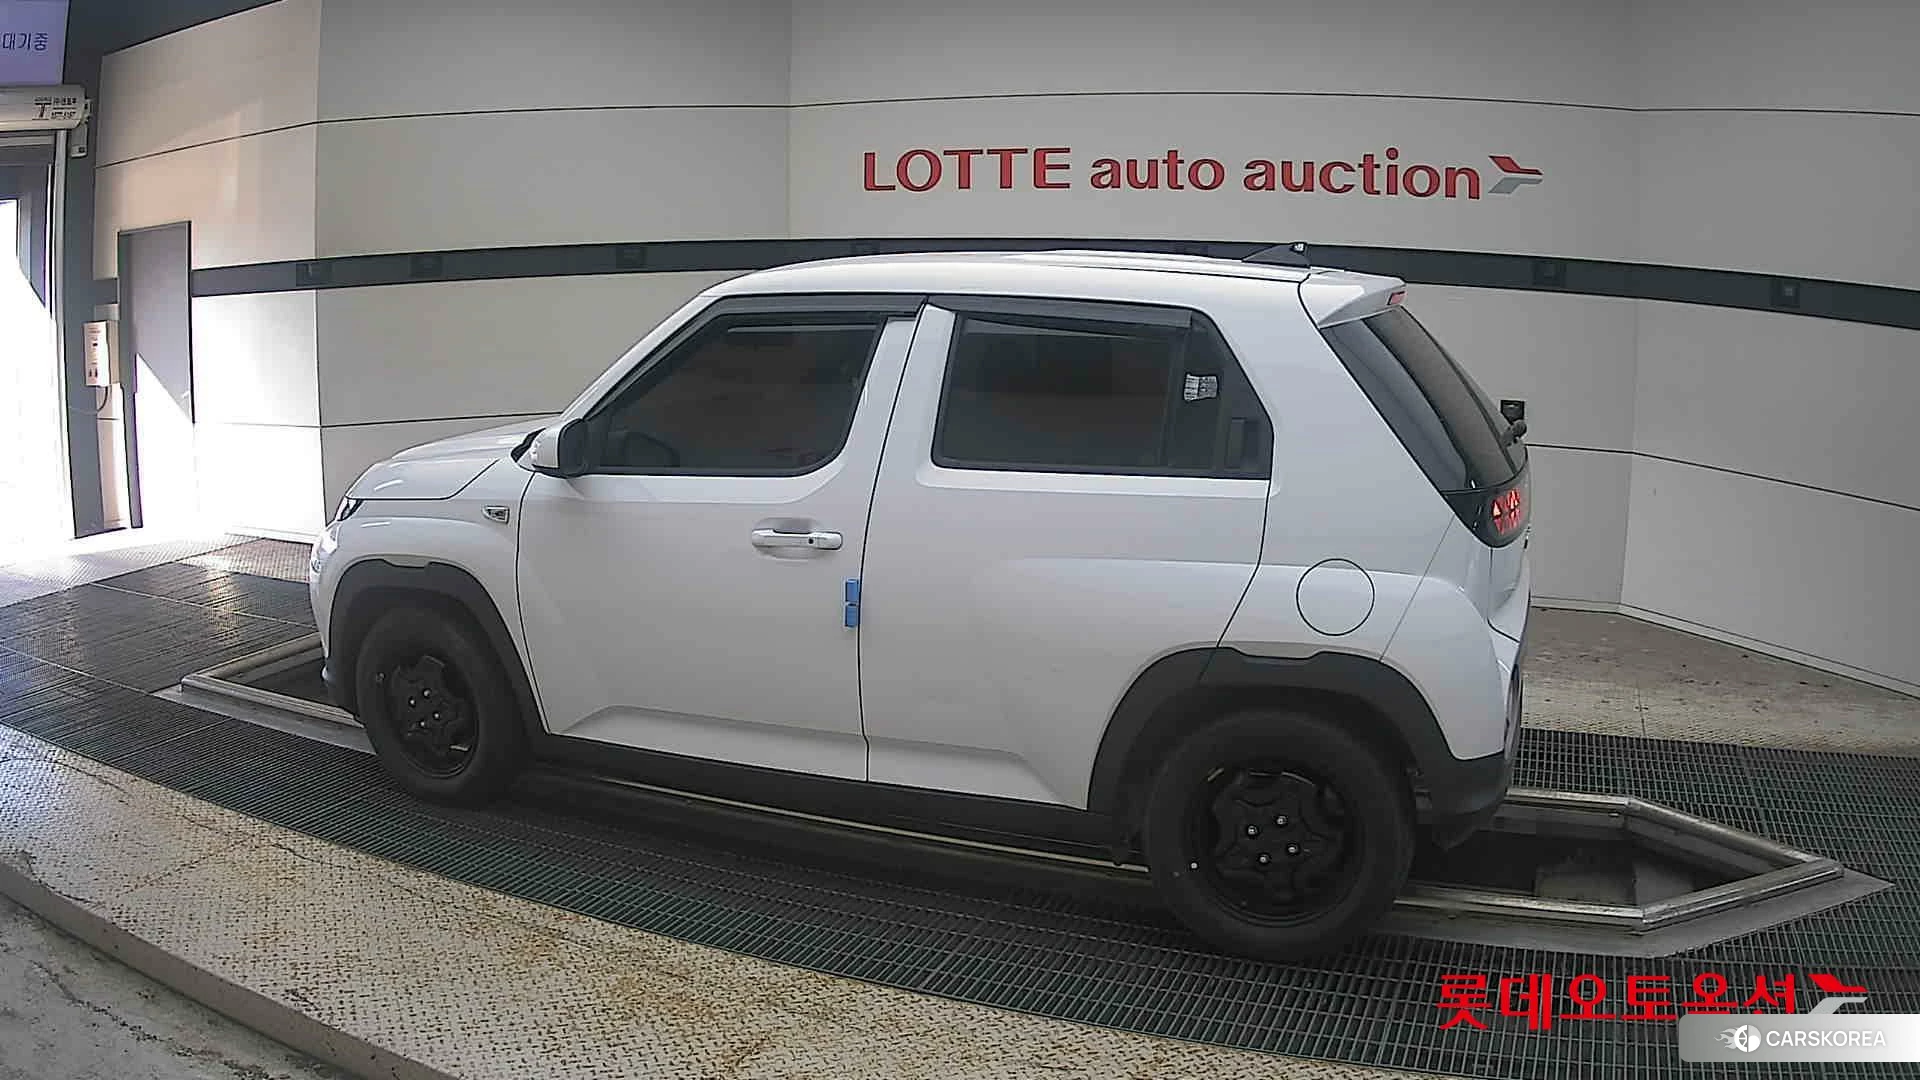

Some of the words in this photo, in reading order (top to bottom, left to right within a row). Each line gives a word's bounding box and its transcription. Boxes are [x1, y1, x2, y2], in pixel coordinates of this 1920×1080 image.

[2, 32, 48, 51] 대기중
[863, 147, 1072, 192] LOTTE
[1090, 149, 1225, 191] auto
[1243, 148, 1481, 200] auction
